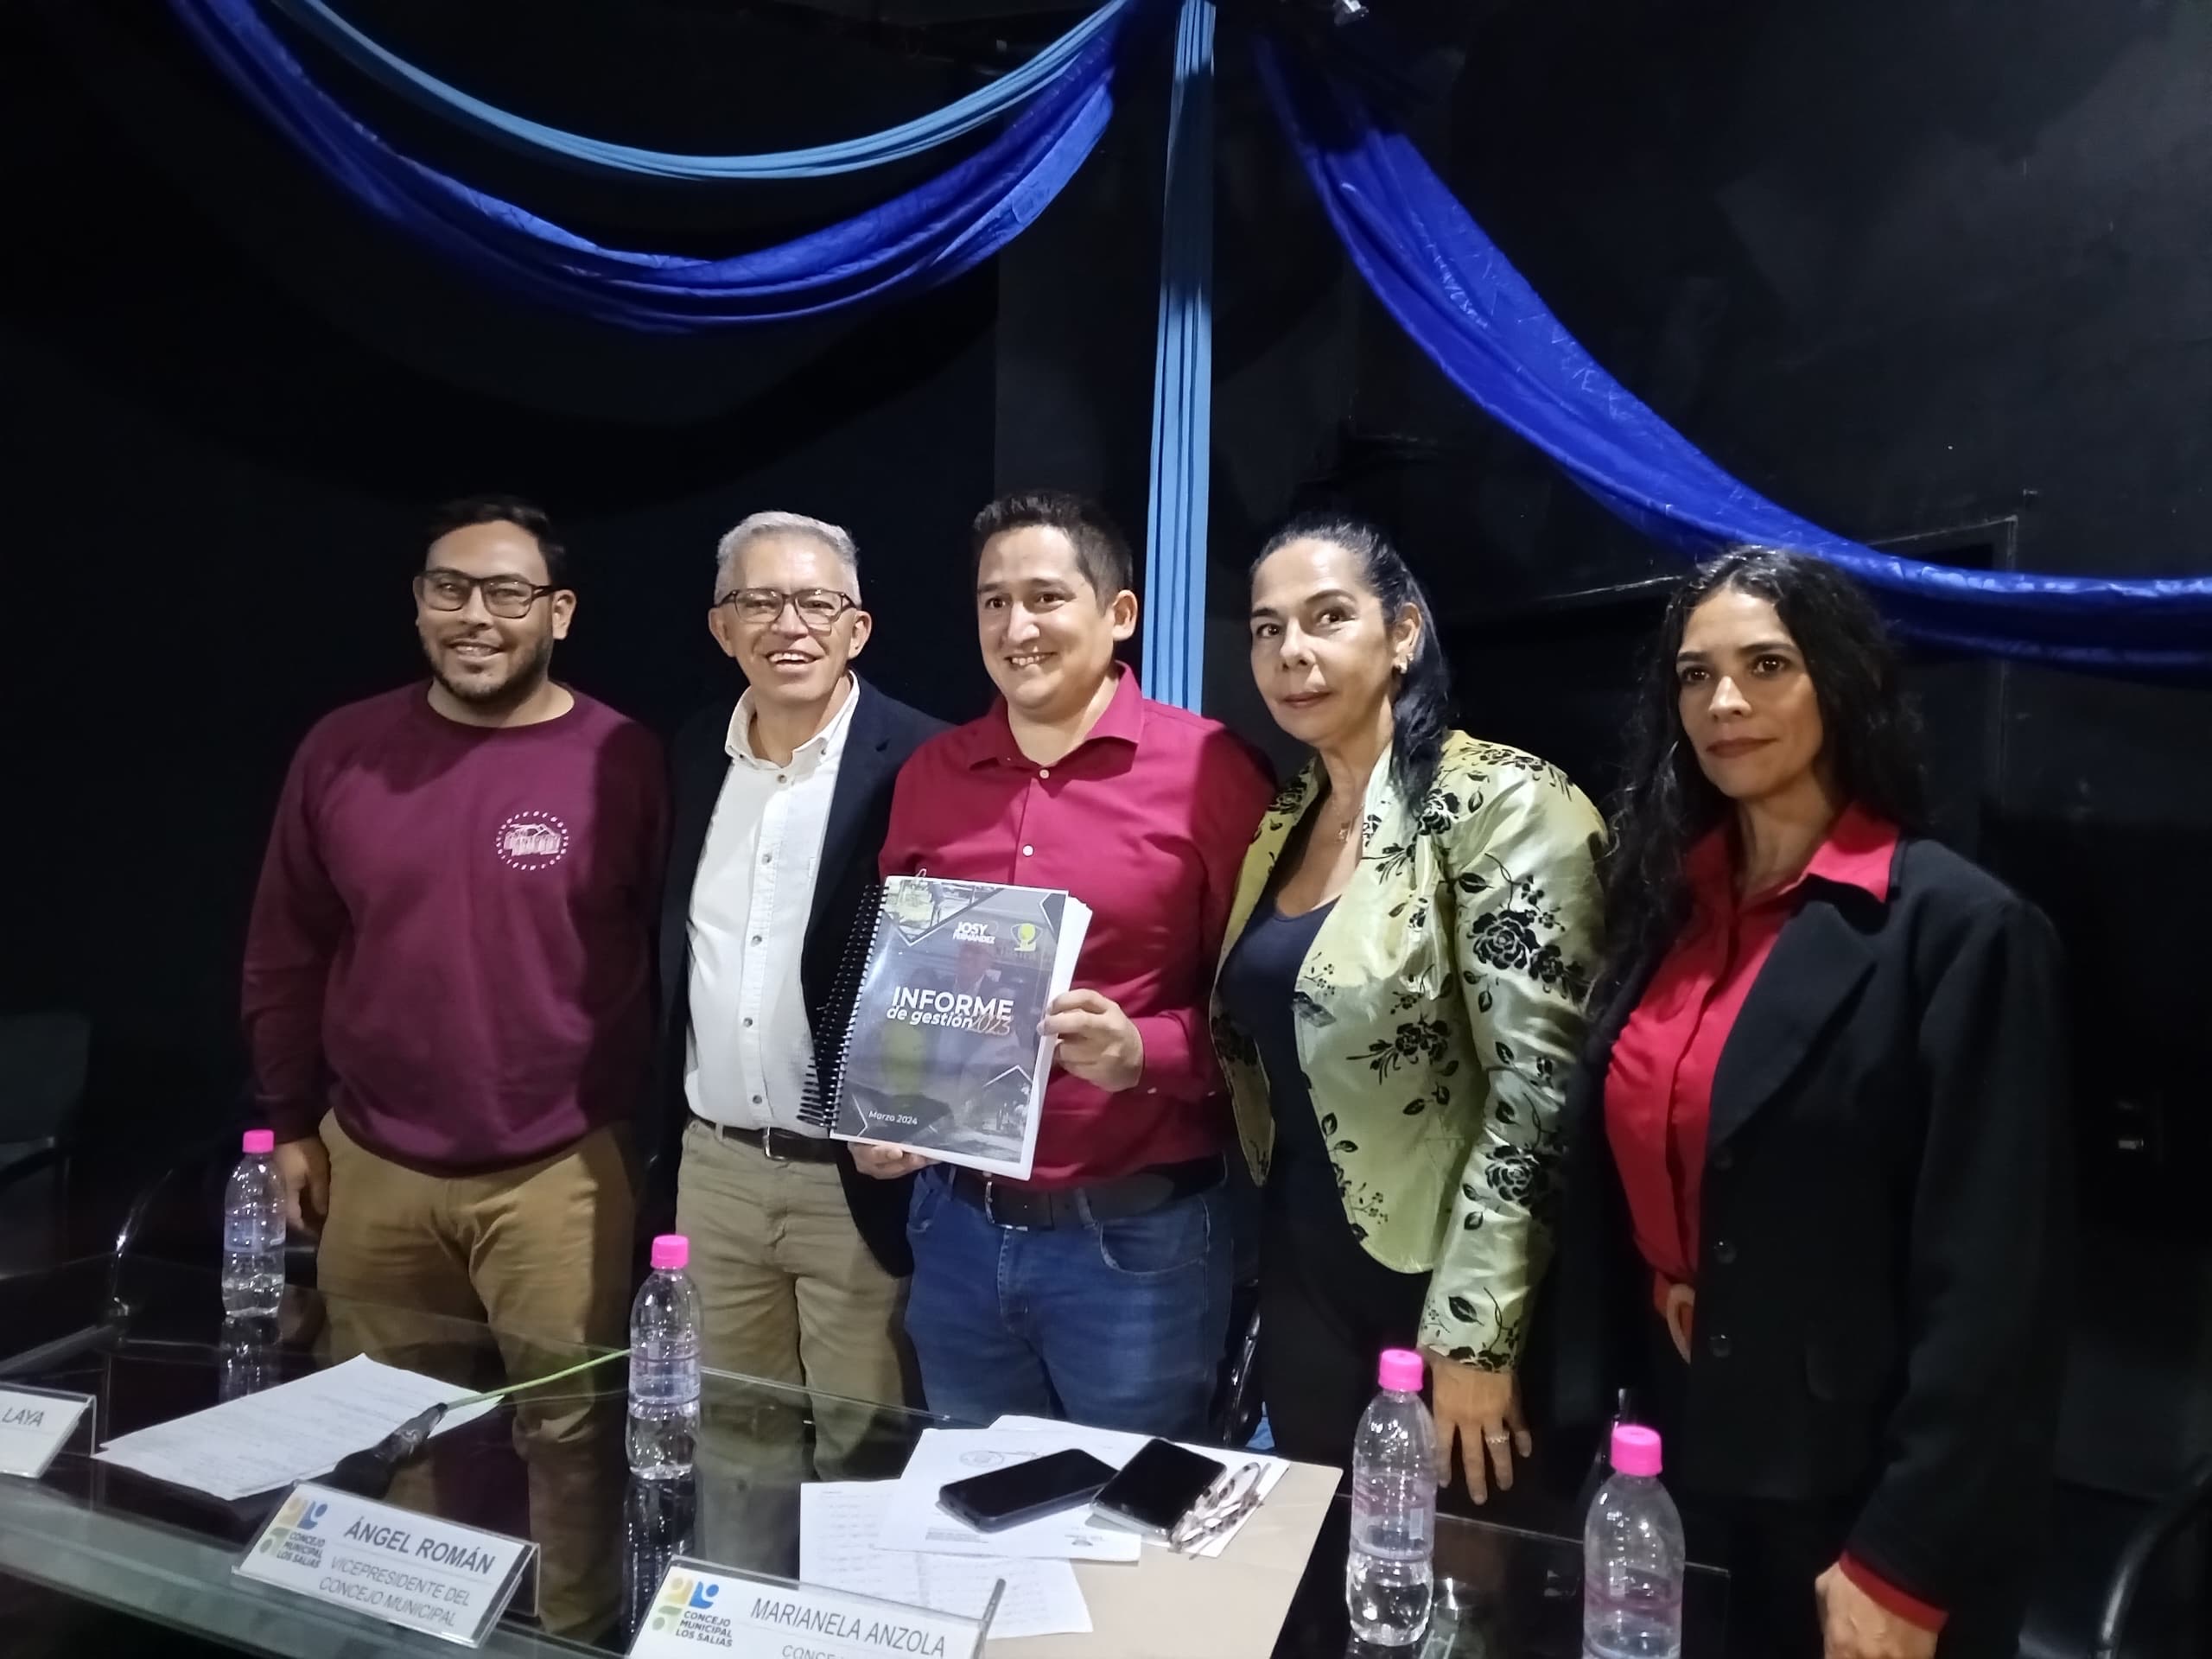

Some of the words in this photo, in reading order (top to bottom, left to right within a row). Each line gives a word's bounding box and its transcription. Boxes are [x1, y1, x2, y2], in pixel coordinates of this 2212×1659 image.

[955, 921, 988, 936] JOSY
[892, 986, 1014, 1021] INFORME
[886, 1005, 906, 1020] de
[910, 1008, 973, 1029] gestión
[868, 1109, 895, 1122] Marzo
[897, 1113, 918, 1126] 2024
[2, 1408, 45, 1427] LAYA
[288, 1530, 326, 1548] CONCEJO
[343, 1515, 411, 1554] ÁNGEL
[416, 1538, 496, 1575] ROMÁN
[276, 1549, 293, 1561] LOS
[291, 1553, 321, 1569] SALIAS
[283, 1541, 325, 1559] MUNICIPAL
[330, 1555, 447, 1599] VICEPRESIDENTE
[443, 1587, 471, 1607] DEL
[318, 1575, 383, 1605] CONCEJO
[385, 1594, 457, 1628] MUNICIPAL
[679, 1618, 733, 1637] MUNICIPAL
[683, 1610, 731, 1627] CONCEJO
[750, 1598, 862, 1641] MARIANELA
[864, 1620, 945, 1657] ANZOLA
[675, 1629, 696, 1641] LOS
[696, 1632, 734, 1648] SALIAS
